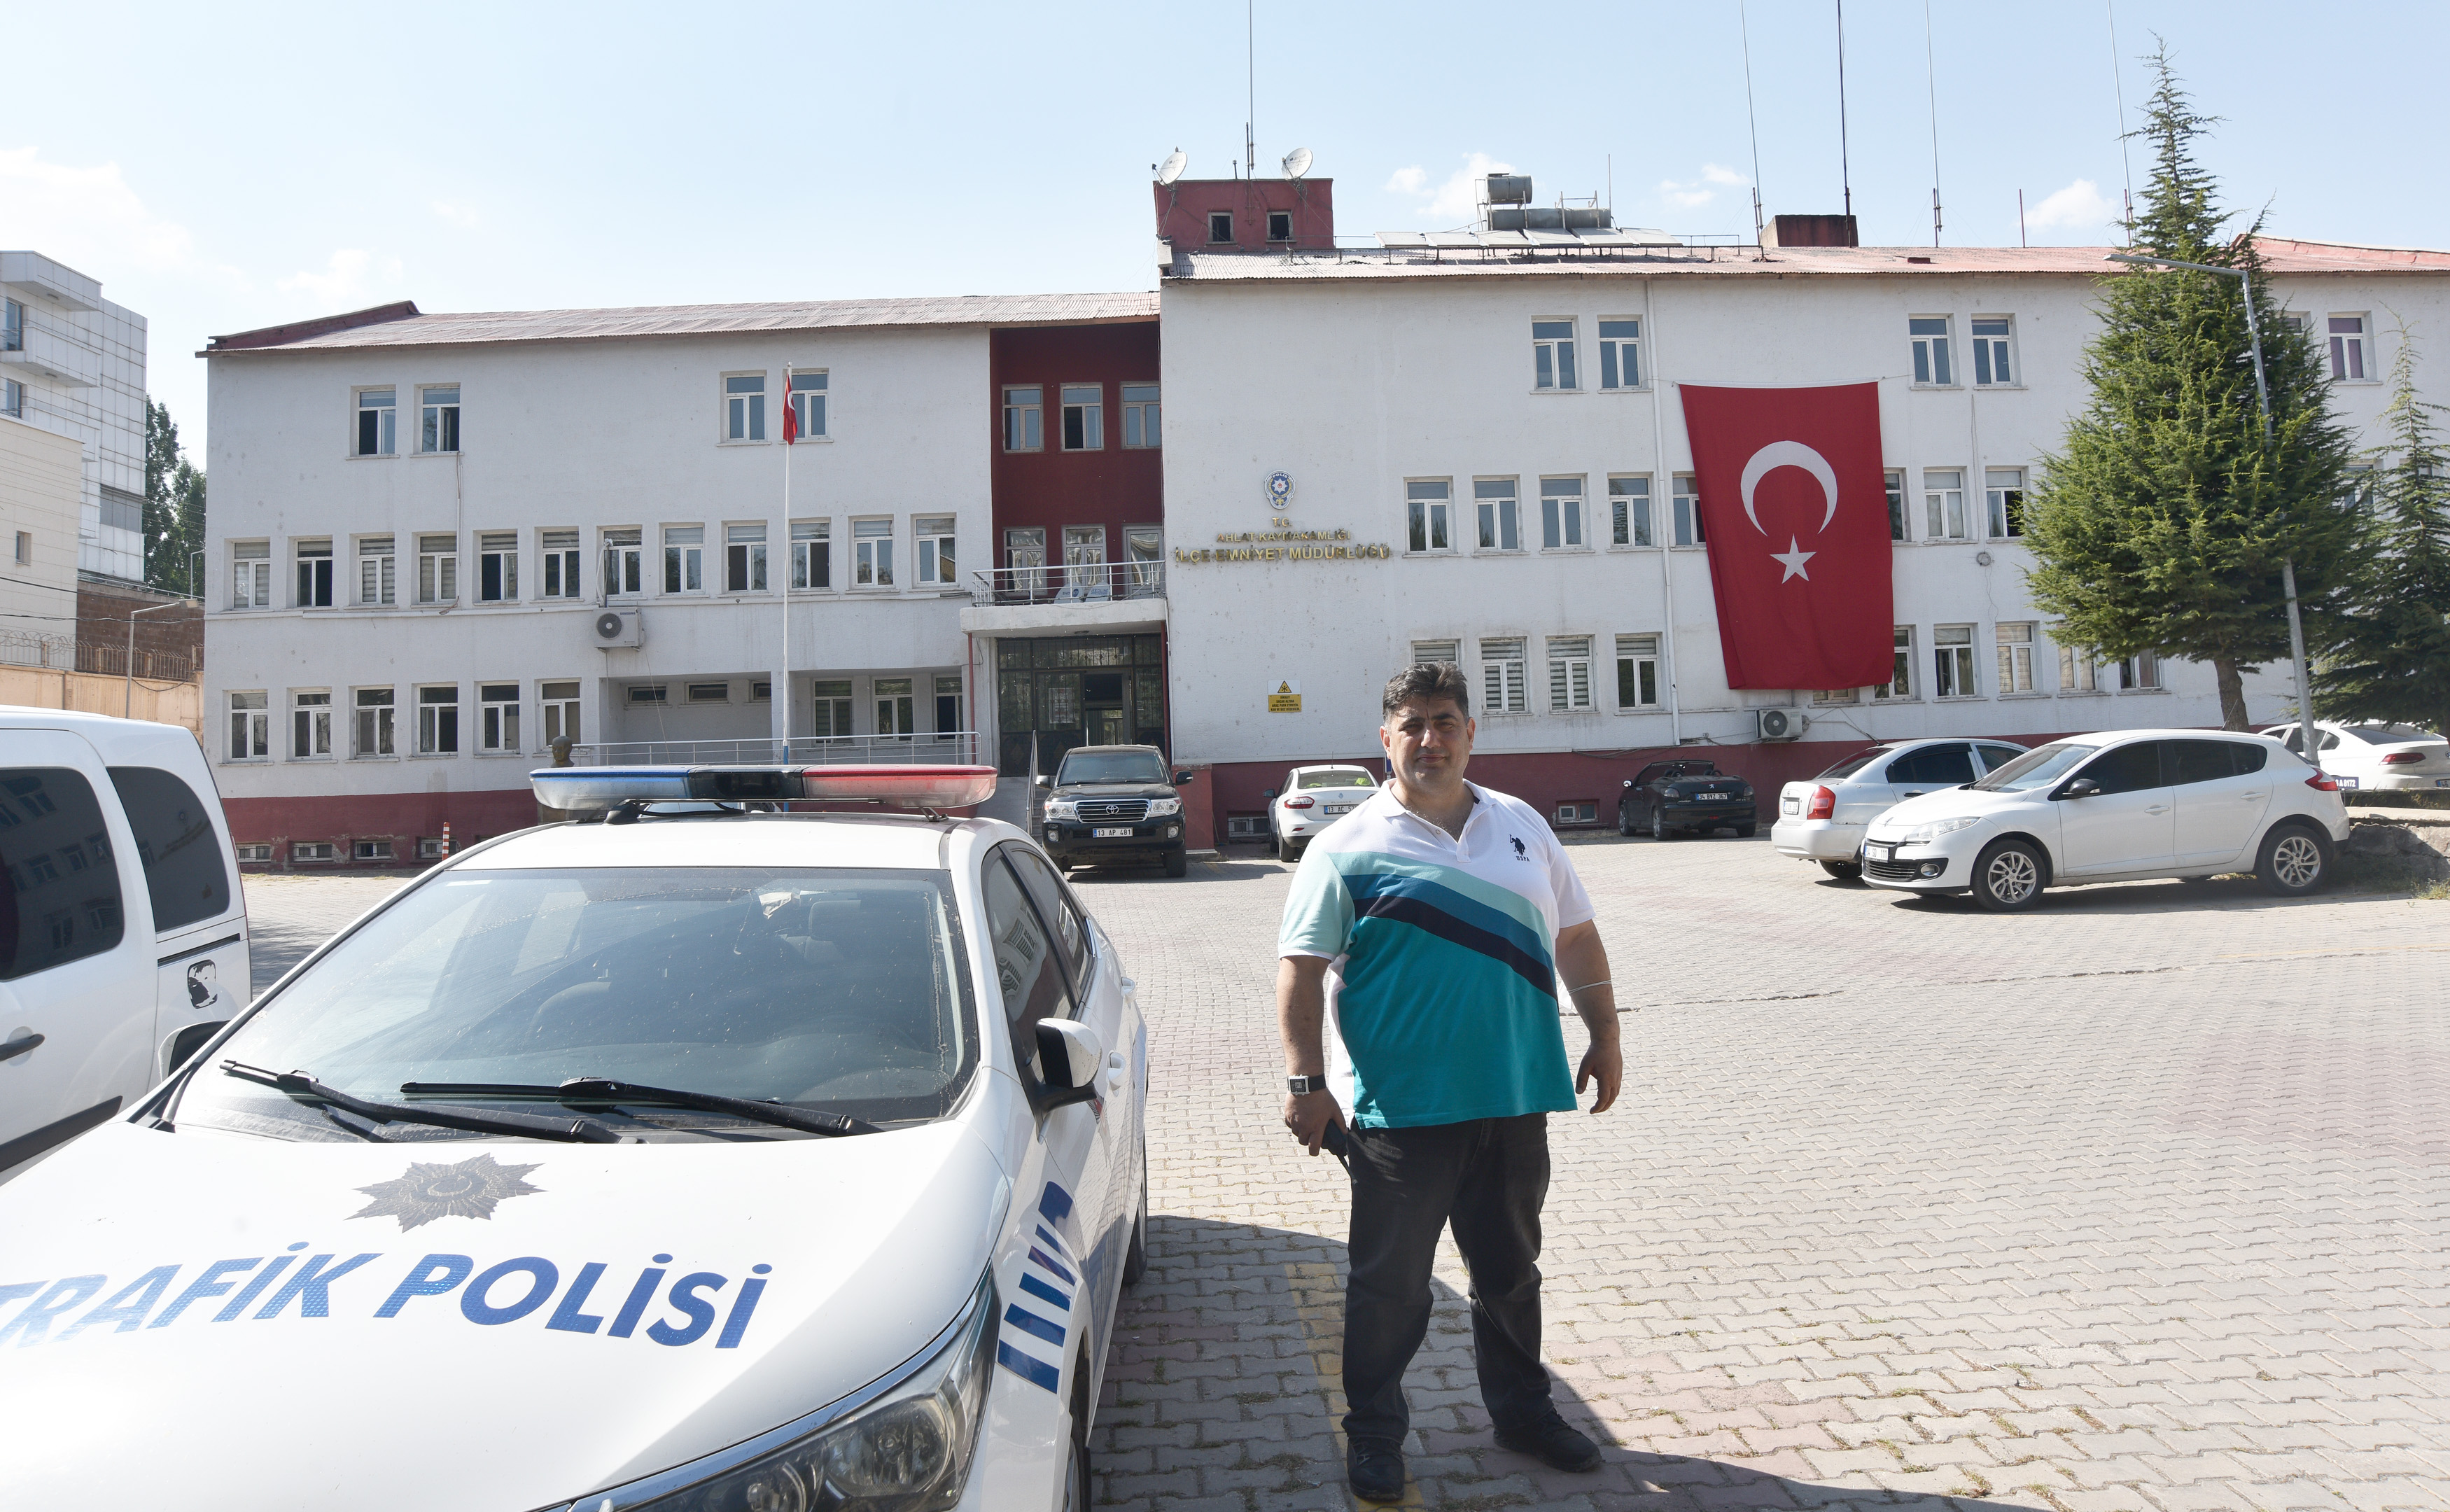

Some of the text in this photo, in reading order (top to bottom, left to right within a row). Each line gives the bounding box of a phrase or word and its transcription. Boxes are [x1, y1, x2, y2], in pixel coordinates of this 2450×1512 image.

[1272, 517, 1292, 527] T.C.
[1217, 528, 1351, 542] AHLAT KAYMAKAMLIĞI
[1175, 542, 1390, 564] İLÇE EMNİYET MÜDÜRLÜĞÜ
[2343, 779, 2356, 788] 8172
[372, 1253, 774, 1350] POLİSİ
